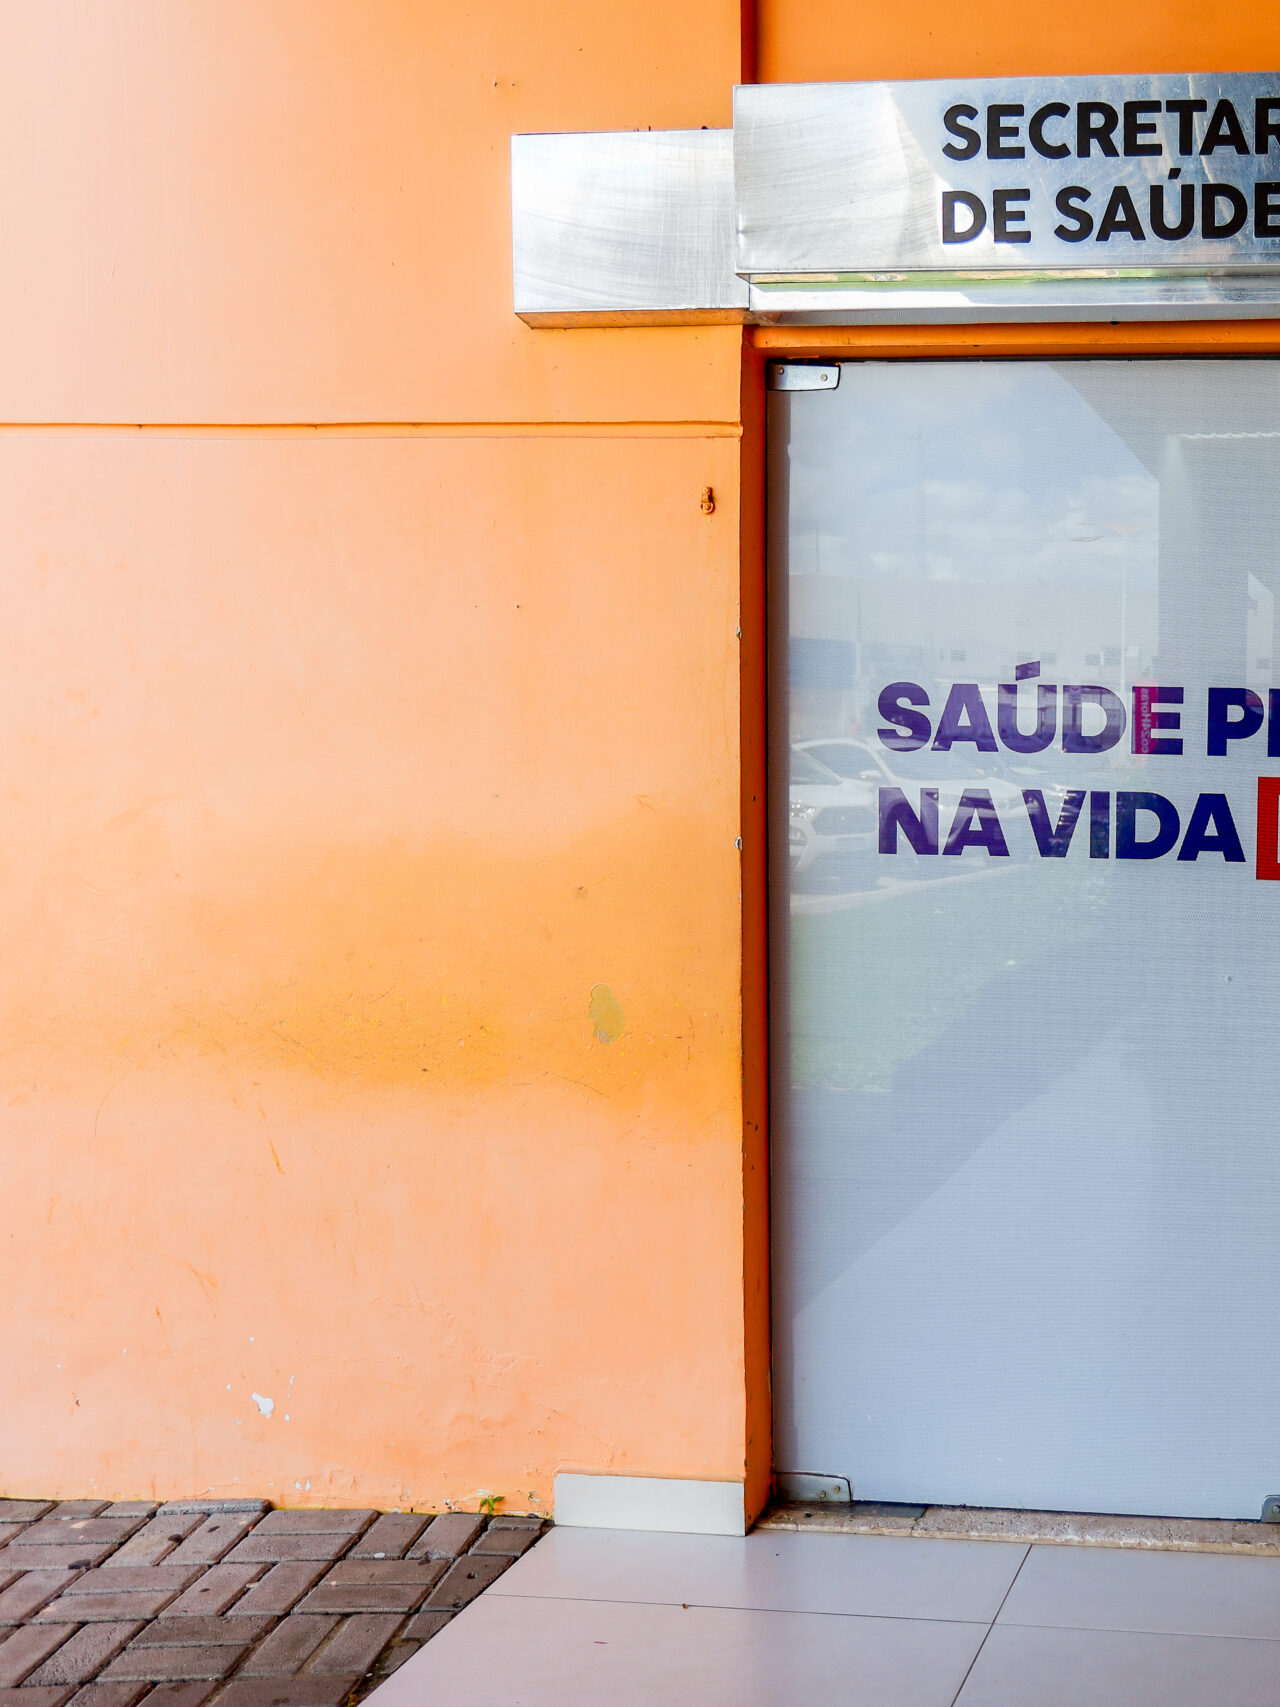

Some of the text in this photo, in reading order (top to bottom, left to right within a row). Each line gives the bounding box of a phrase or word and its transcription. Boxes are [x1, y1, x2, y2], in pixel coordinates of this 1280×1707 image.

[941, 187, 1032, 244] DE
[876, 660, 1185, 757] SAÚDE
[877, 786, 1011, 858] NA
[1021, 788, 1247, 864] VIDA
